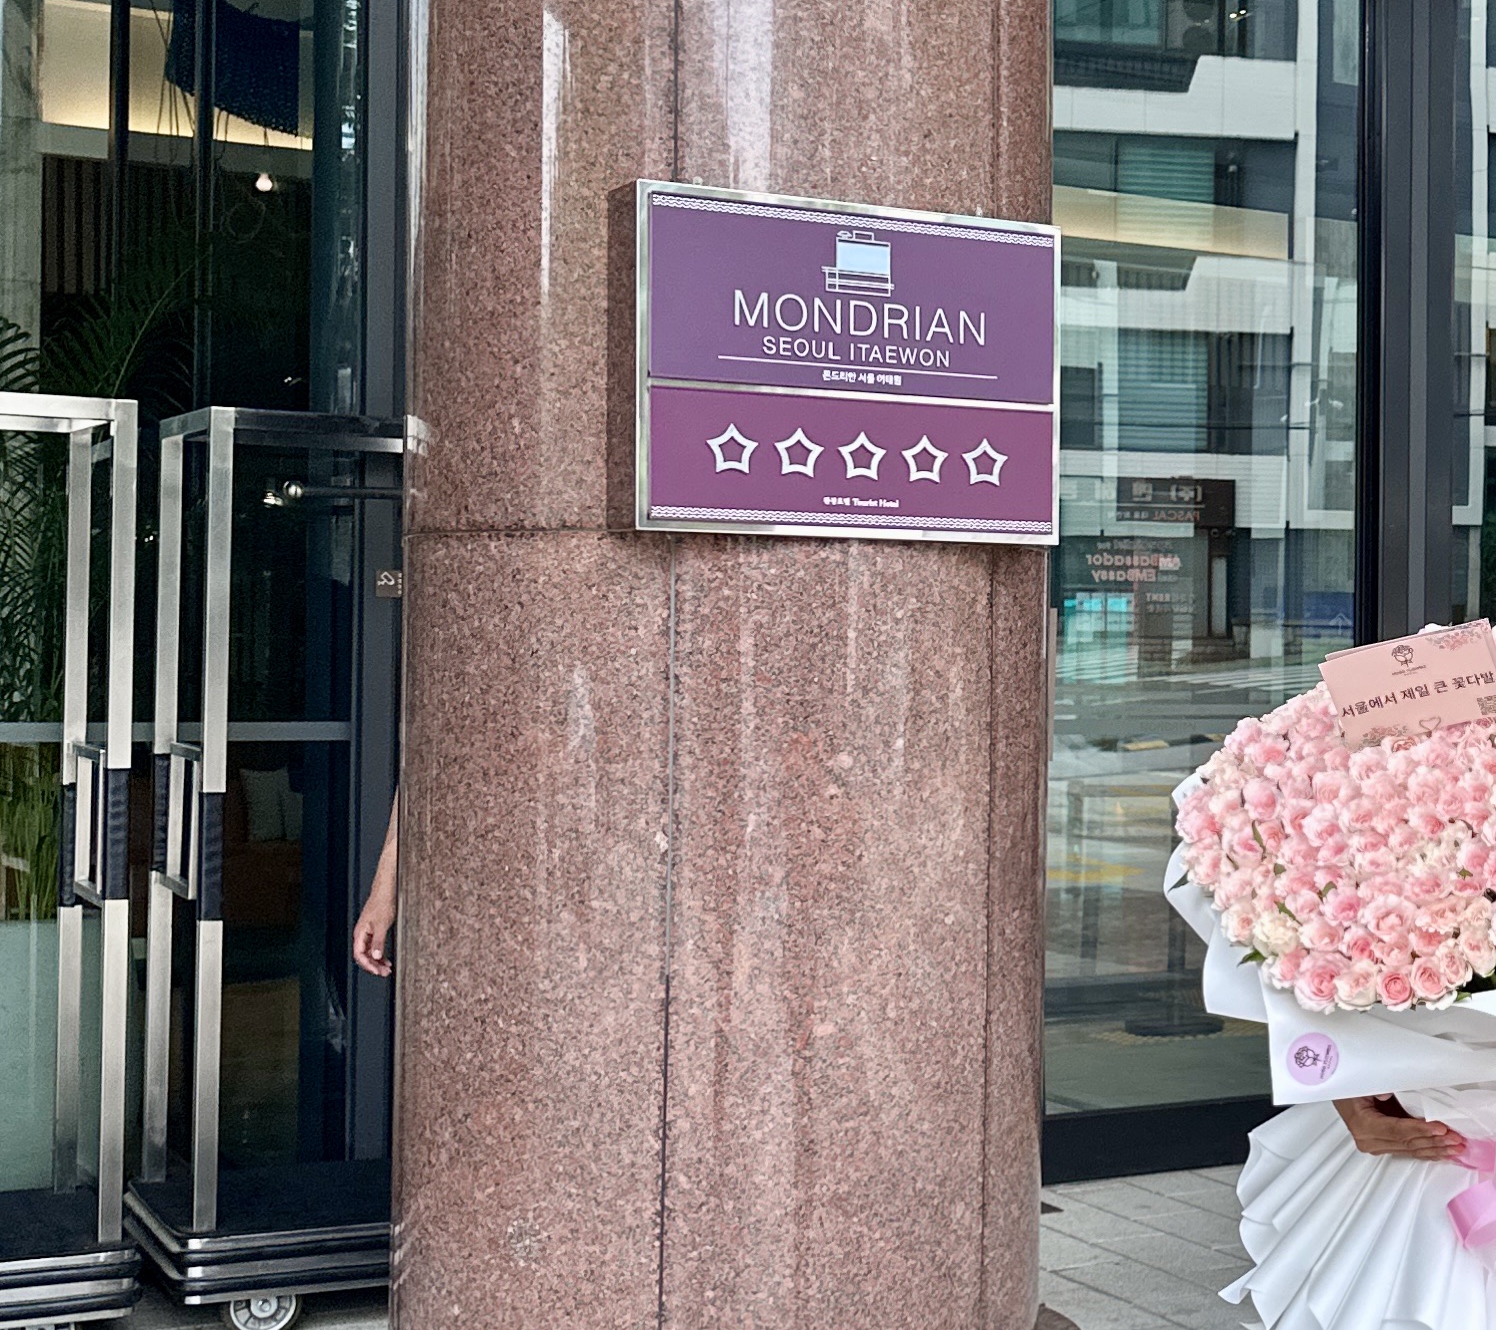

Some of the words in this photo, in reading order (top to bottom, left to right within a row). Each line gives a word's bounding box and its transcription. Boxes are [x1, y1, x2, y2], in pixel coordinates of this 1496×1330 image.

[733, 289, 986, 346] MONDRIAN
[762, 336, 841, 360] SEOUL
[850, 343, 950, 367] ITAEWON
[1341, 692, 1398, 718] 서울에서
[1400, 684, 1431, 700] 제일
[1434, 680, 1448, 694] 큰
[1452, 671, 1495, 690] 꽃다발
